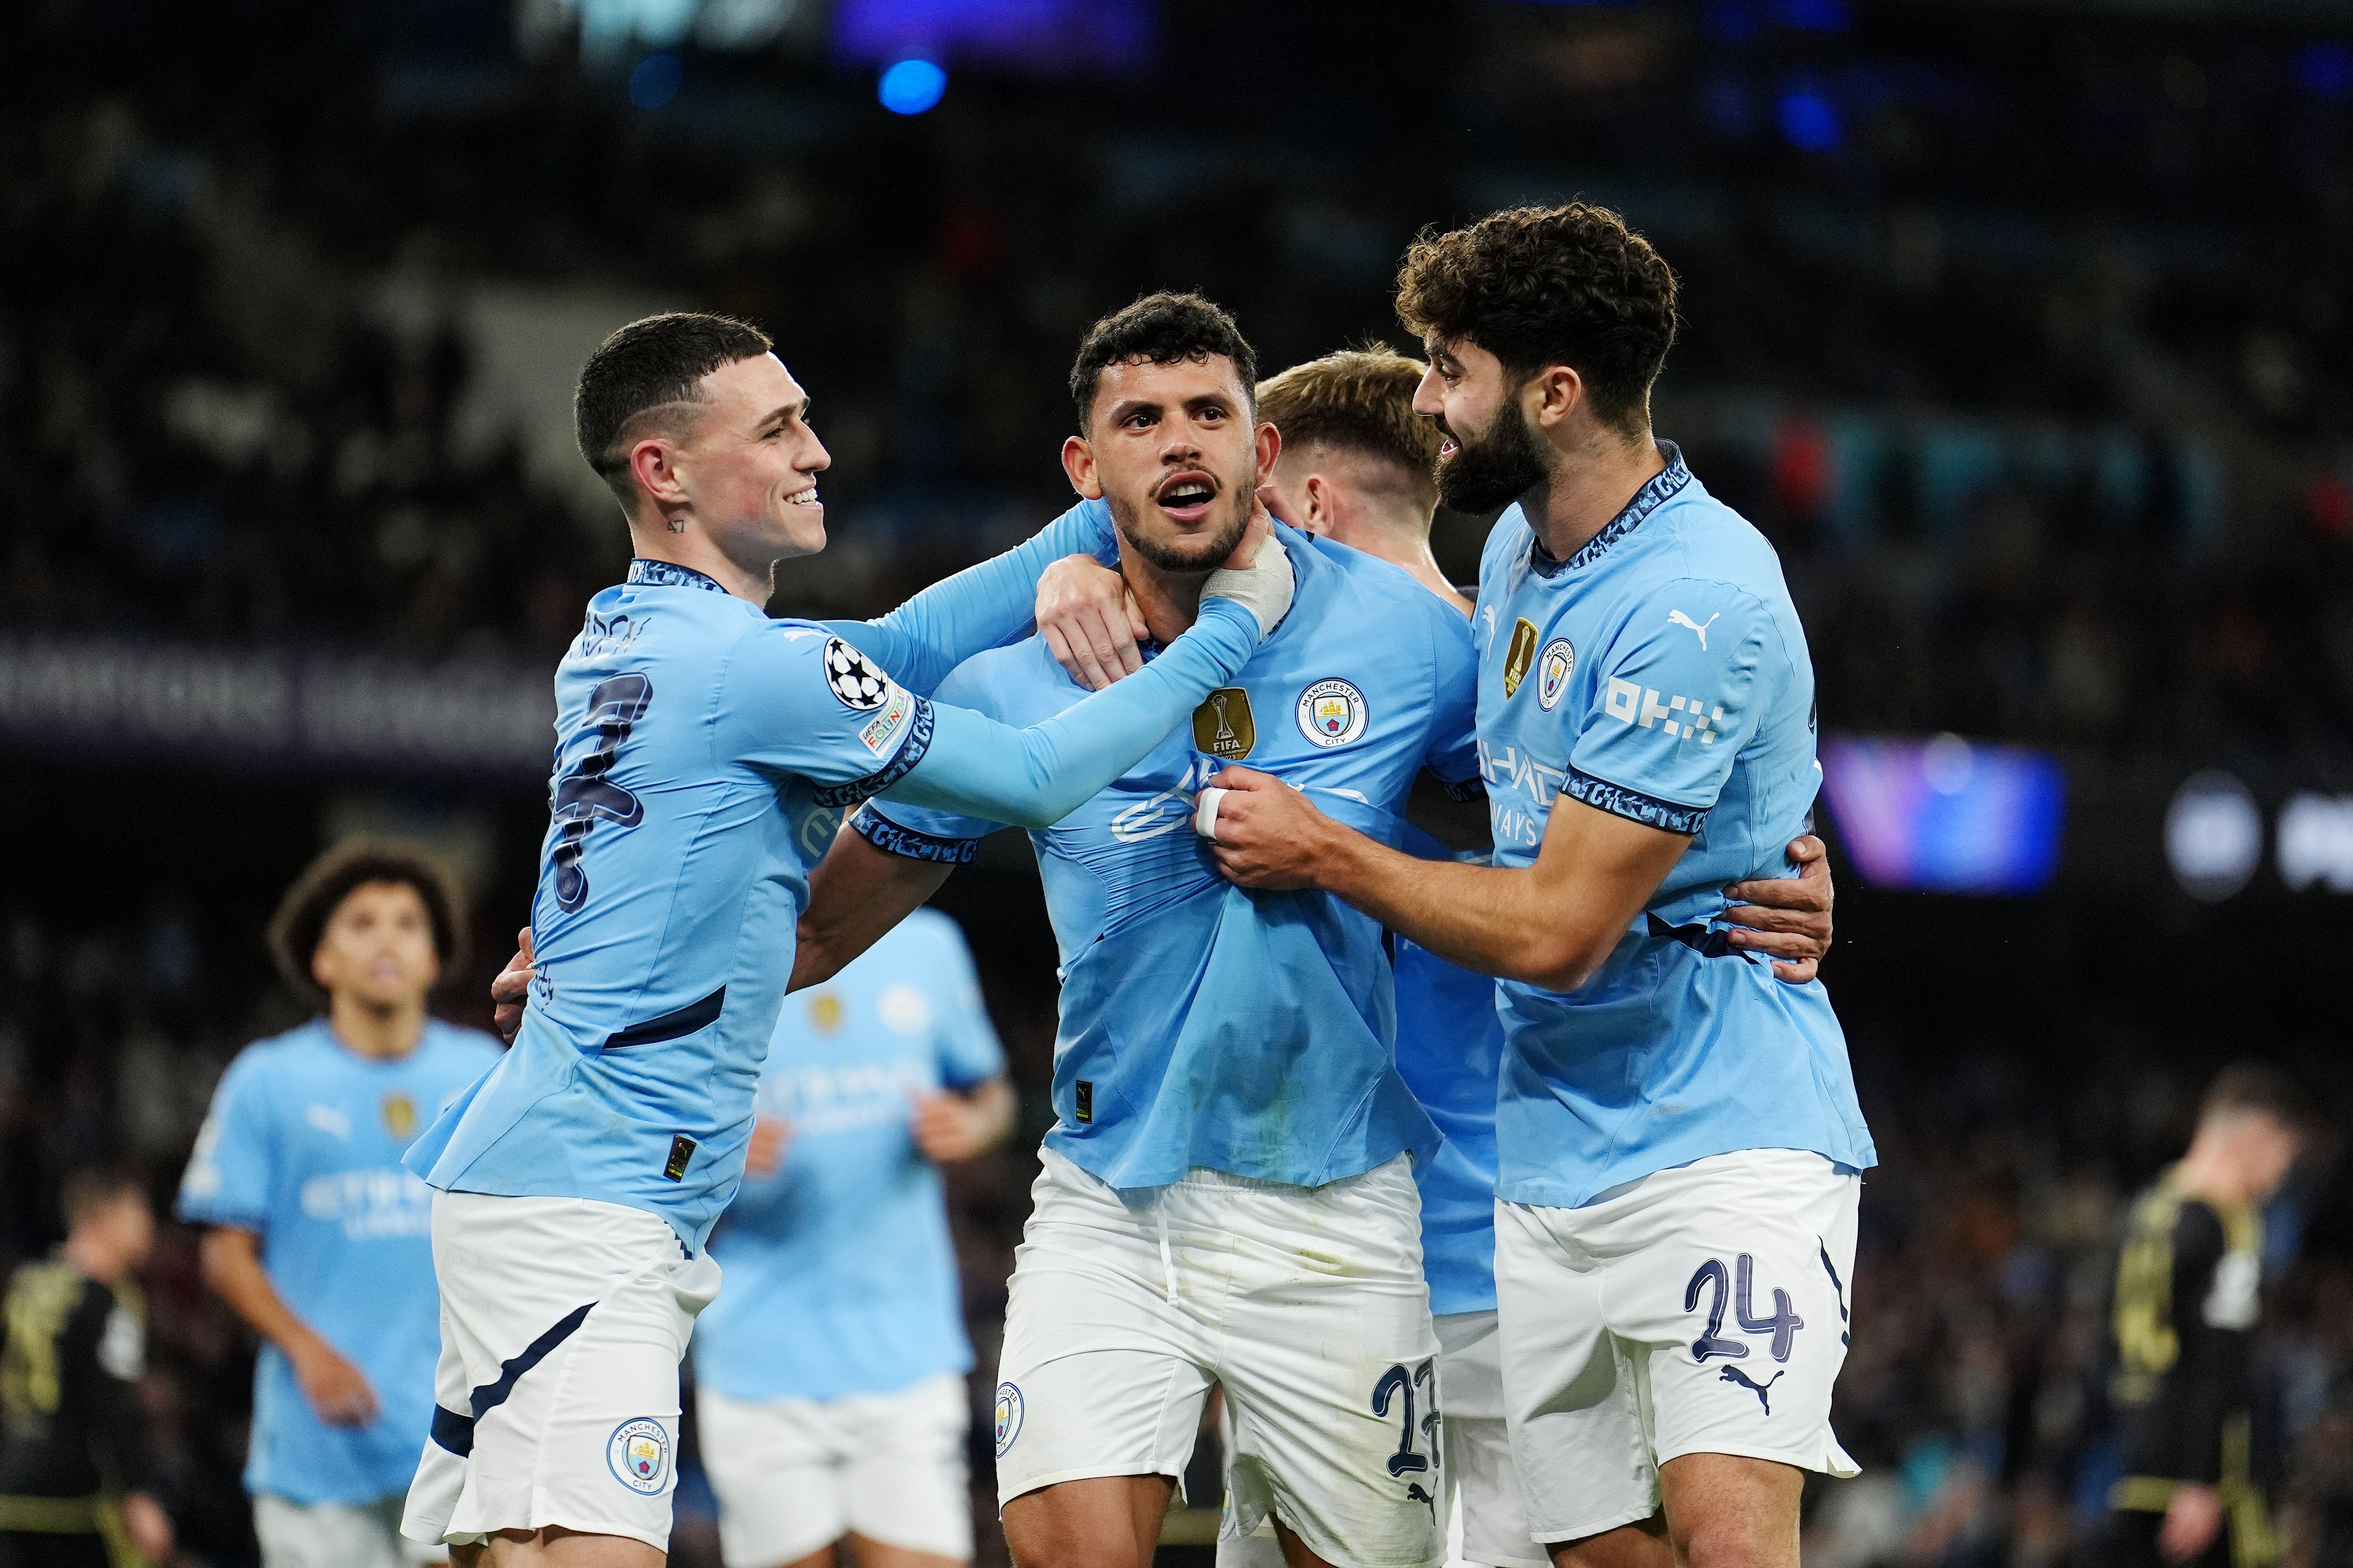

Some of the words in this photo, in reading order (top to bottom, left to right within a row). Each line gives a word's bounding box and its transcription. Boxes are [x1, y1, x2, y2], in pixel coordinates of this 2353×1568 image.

[1546, 644, 1574, 673] MANCHESTER
[1508, 667, 1520, 686] FIFA
[1302, 683, 1359, 707] MANCHESTER
[1542, 697, 1551, 707] CITY
[867, 687, 906, 749] FOUNDAT
[1604, 675, 1725, 744] OKX
[862, 720, 882, 740] UEFA
[1213, 739, 1241, 752] FIFA
[1489, 798, 1537, 846] WAYS
[1683, 1252, 1804, 1363] 24
[997, 1388, 1017, 1404] HESTER
[1371, 1356, 1441, 1478] 27
[617, 1423, 667, 1453] MANCHESTER
[997, 1441, 1007, 1453] CITY
[633, 1480, 652, 1490] CITY
